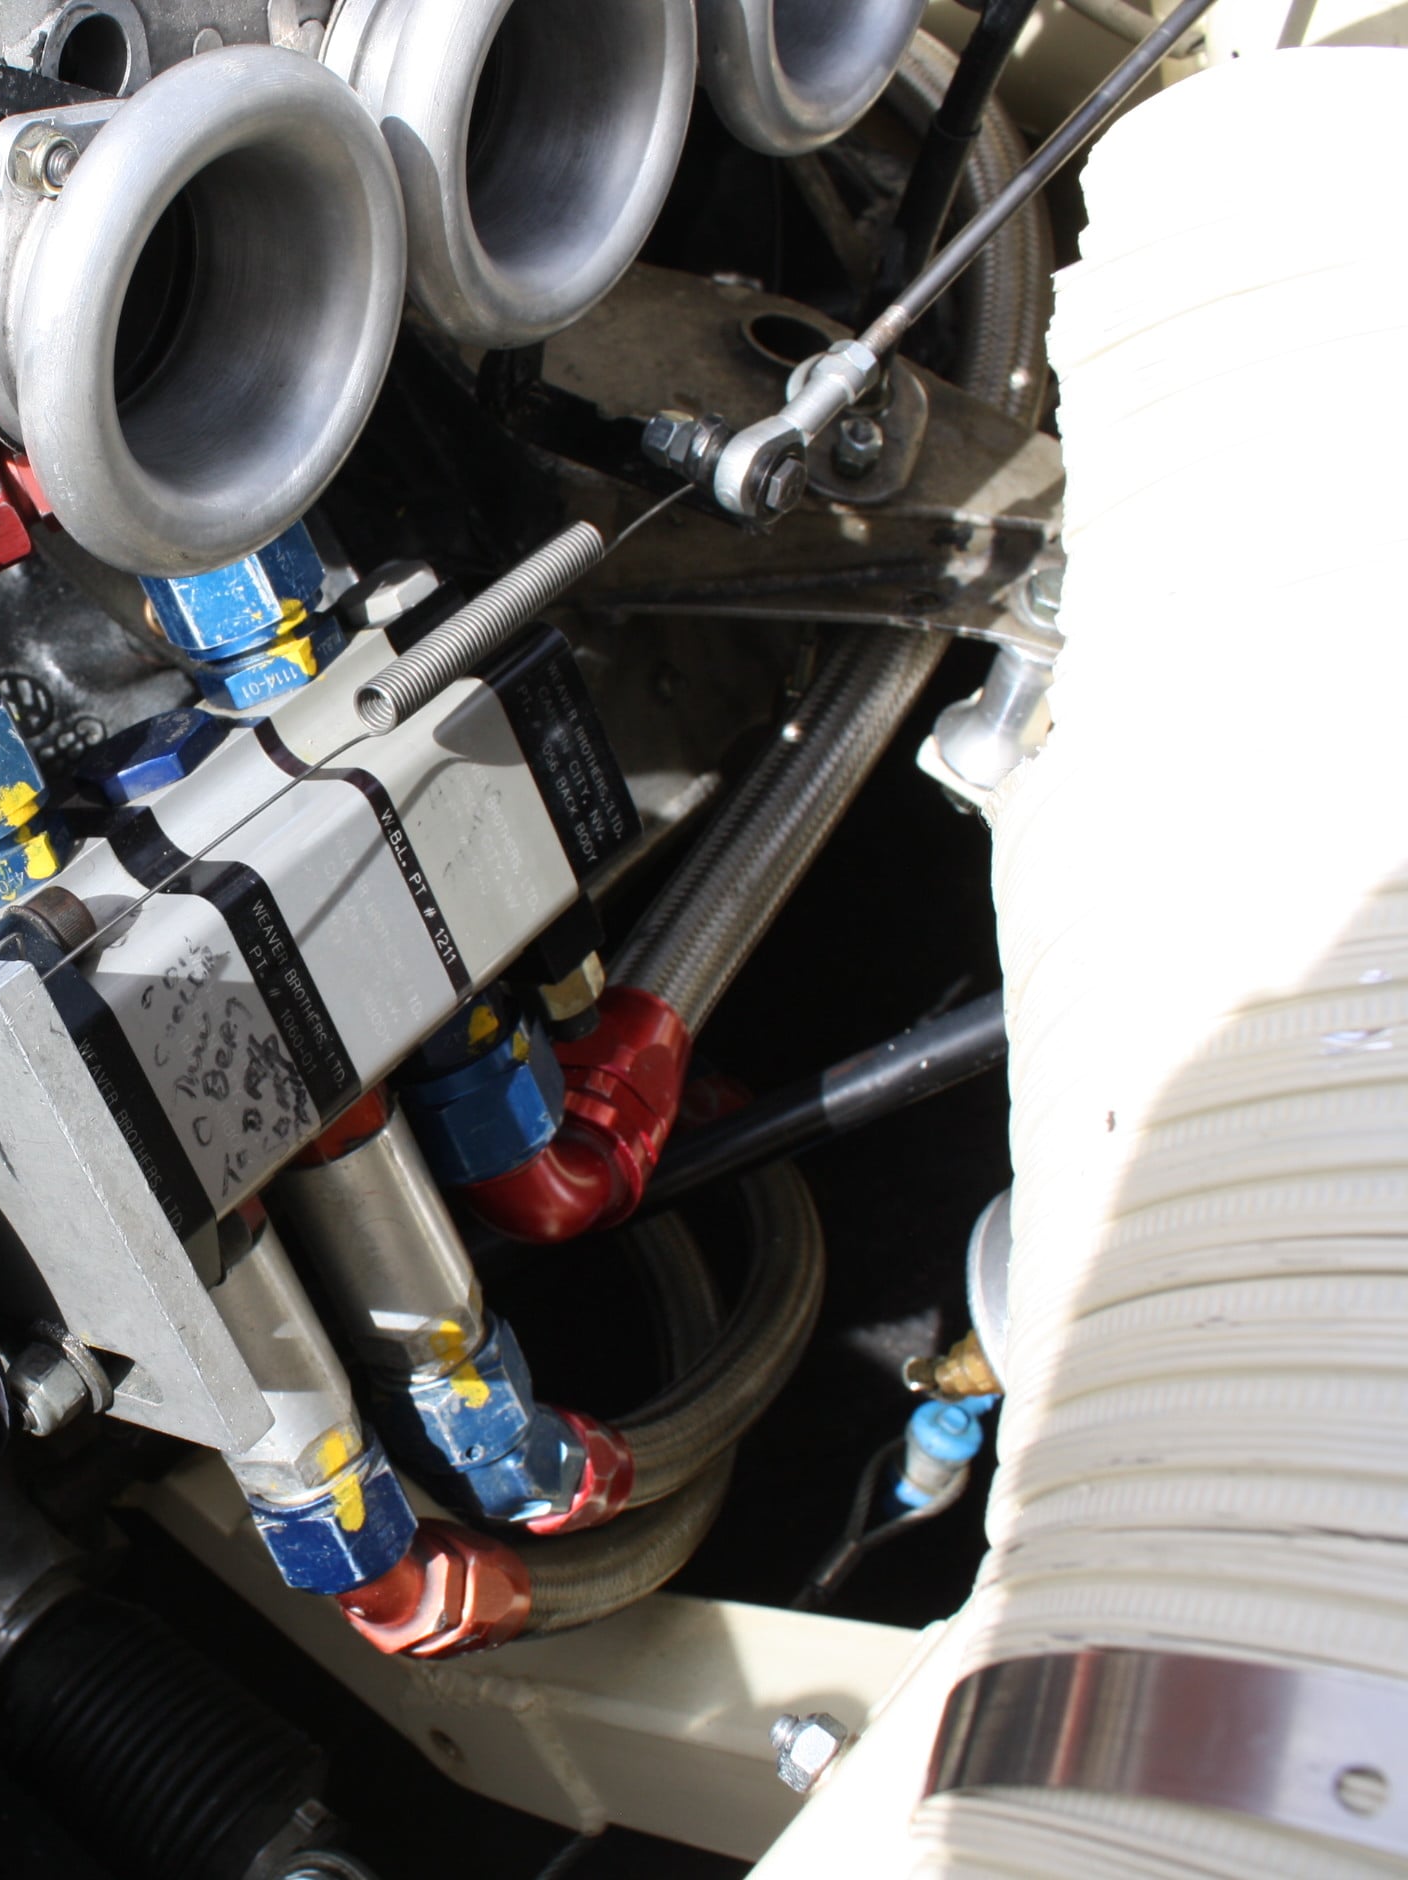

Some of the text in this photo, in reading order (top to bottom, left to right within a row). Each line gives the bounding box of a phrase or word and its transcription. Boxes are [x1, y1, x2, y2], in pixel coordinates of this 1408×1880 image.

[555, 775, 579, 817] BACK
[572, 821, 598, 862] BODY
[379, 807, 411, 868] W.B.L.
[407, 870, 427, 896] PT
[432, 926, 458, 966] 1211
[250, 898, 289, 965] WEAVER
[76, 1036, 119, 1107] WEAVER
